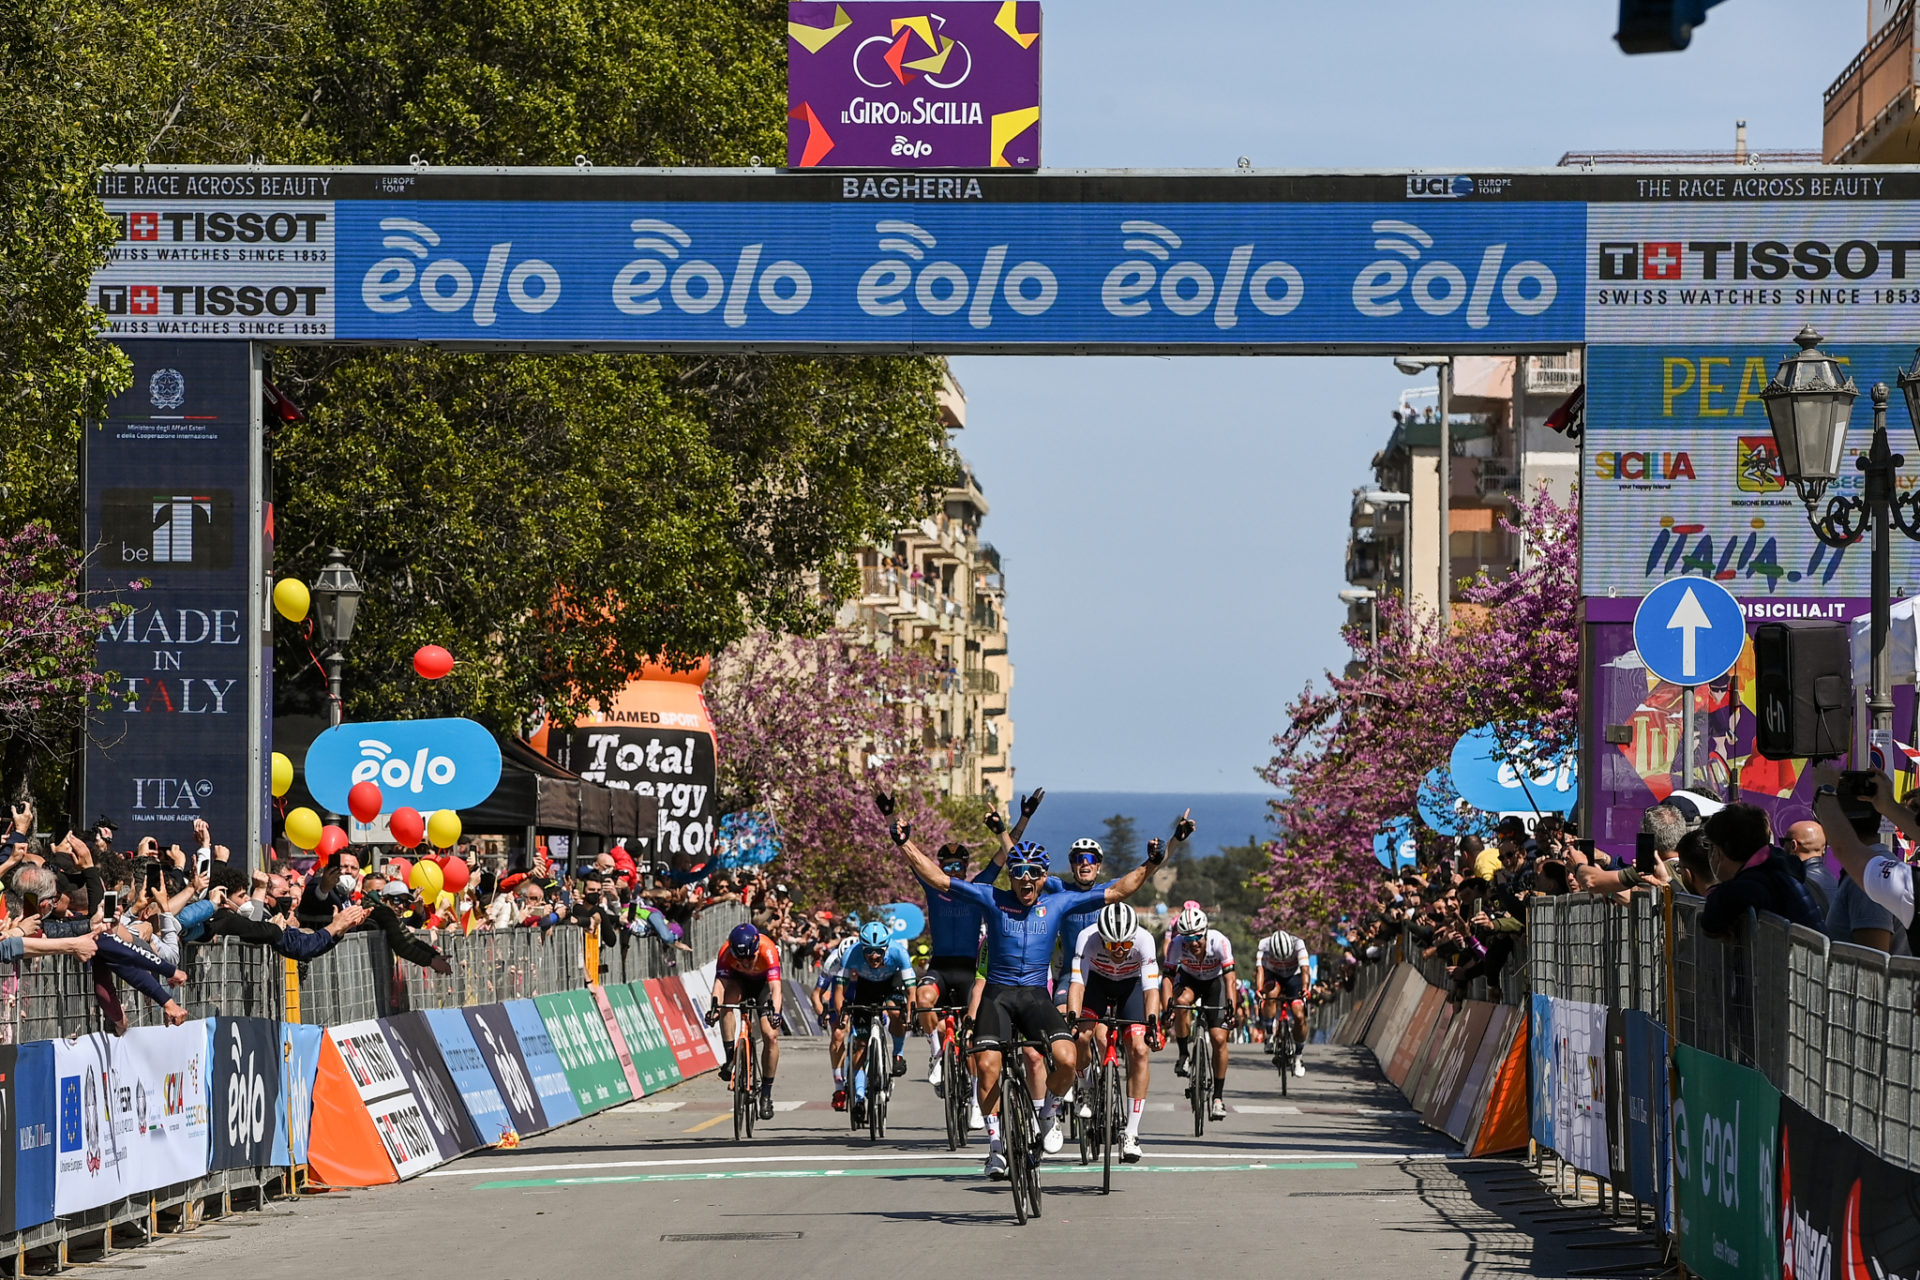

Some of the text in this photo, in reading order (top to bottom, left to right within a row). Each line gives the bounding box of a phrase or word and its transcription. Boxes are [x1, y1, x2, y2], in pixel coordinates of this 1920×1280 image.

[912, 97, 983, 125] SICILIA
[891, 140, 932, 158] eolo
[134, 176, 180, 195] RACE
[186, 176, 255, 195] ACROSS
[261, 176, 330, 195] BEAUTY
[382, 177, 415, 185] EUROPE
[842, 177, 983, 198] BAGHERIA
[1410, 178, 1449, 195] UCI
[1478, 178, 1512, 186] EUROPE
[1636, 177, 1885, 197] THE RACE ACROSS BEAUTY
[162, 212, 327, 243] TISSOT
[101, 249, 327, 261] WISS WATCHES SINCE 1853
[1689, 240, 1920, 280] TISSOT
[361, 241, 561, 327] eolo
[611, 242, 812, 328] eolo
[857, 243, 1058, 329] eolo
[1101, 243, 1304, 329] eolo
[1352, 242, 1558, 329] eolo
[1598, 288, 1920, 305] SWISS WATCHES SINCE 1853
[162, 285, 327, 316] TISSOT
[157, 322, 230, 334] WATCHES
[239, 322, 285, 334] SINCE
[293, 323, 327, 334] 1853
[1595, 452, 1696, 480] SICILIA
[122, 541, 149, 561] be
[97, 608, 241, 644] MADE
[152, 651, 182, 670] IN
[587, 734, 695, 775] Total
[352, 747, 456, 793] eolo
[132, 778, 200, 809] ITA
[132, 814, 155, 822] ITALIAN
[156, 814, 175, 822] TRADE
[1004, 918, 1047, 934] ITALIA
[495, 1034, 535, 1124] eolo
[228, 1050, 265, 1160] eolo
[1702, 1100, 1740, 1213] enel
